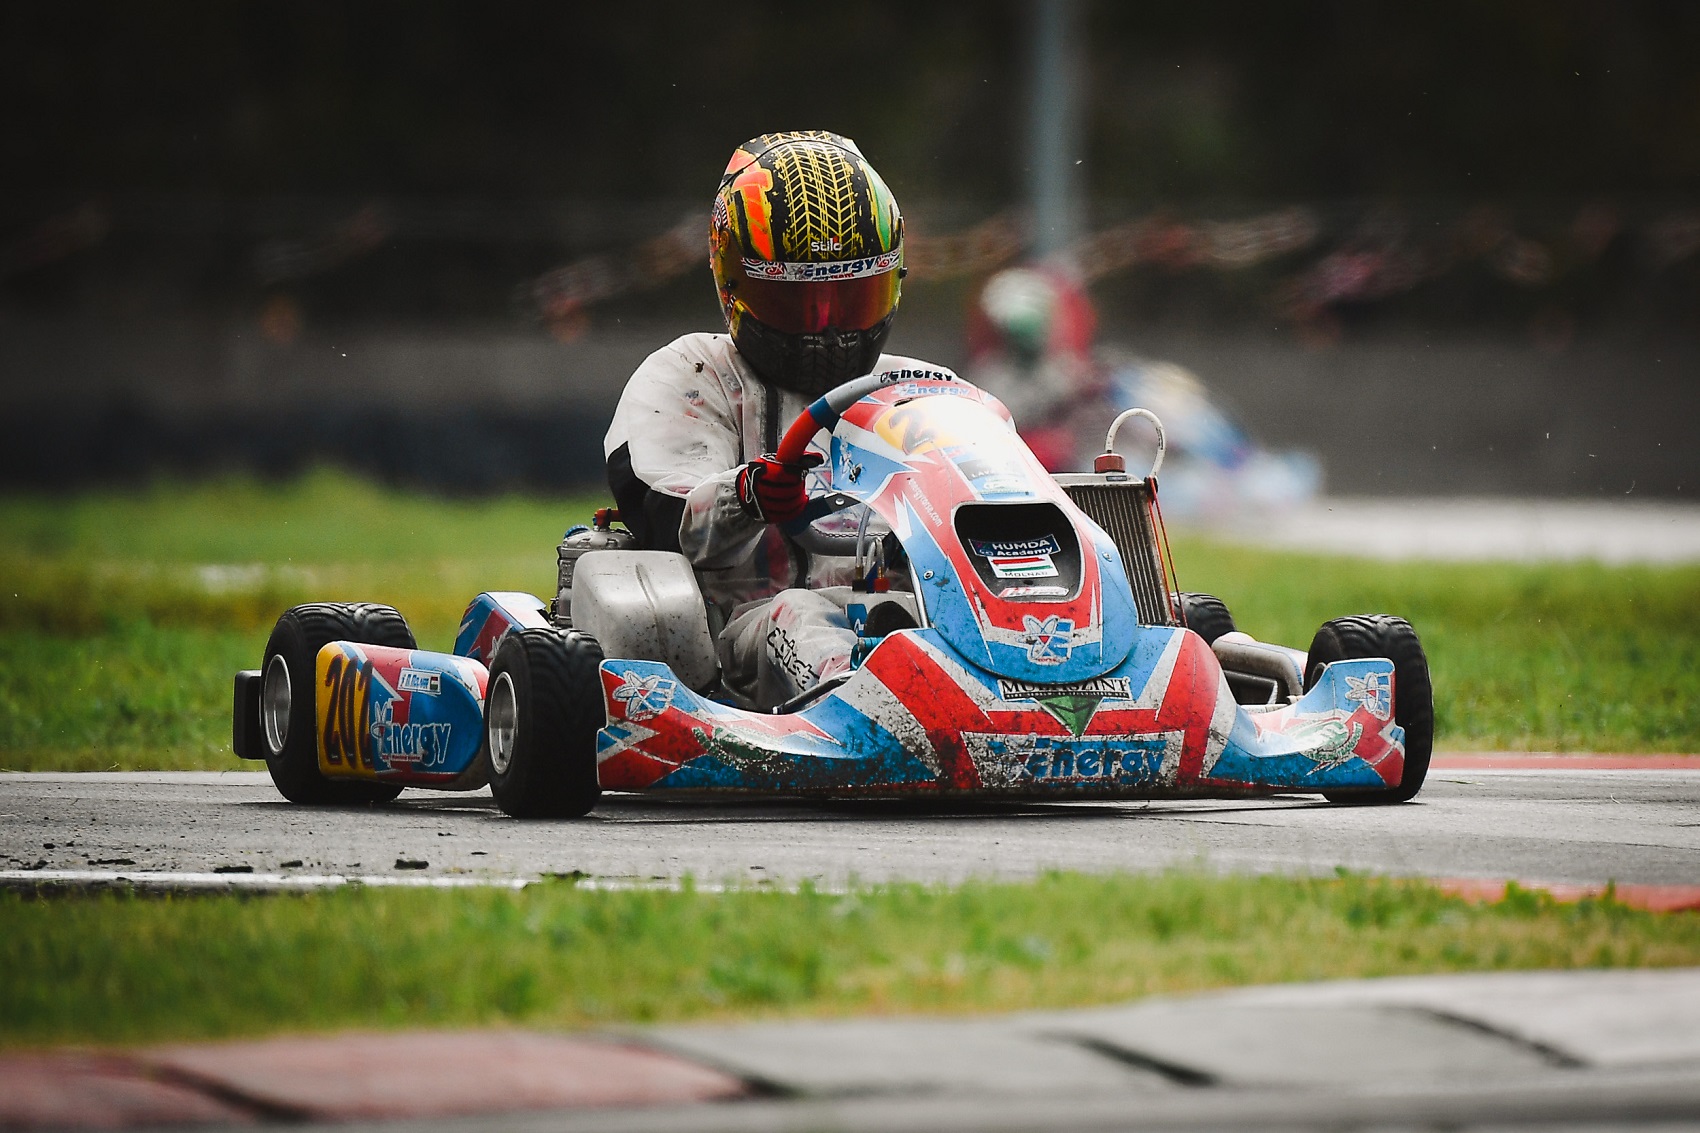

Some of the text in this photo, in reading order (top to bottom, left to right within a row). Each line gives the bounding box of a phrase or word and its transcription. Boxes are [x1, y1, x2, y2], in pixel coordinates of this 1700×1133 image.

[804, 258, 876, 277] Energy
[907, 384, 970, 396] Energy
[992, 540, 1050, 550] HUMDA
[996, 546, 1053, 557] Academy
[324, 654, 374, 768] 202
[383, 708, 451, 767] Energy
[1025, 737, 1166, 786] Energy
